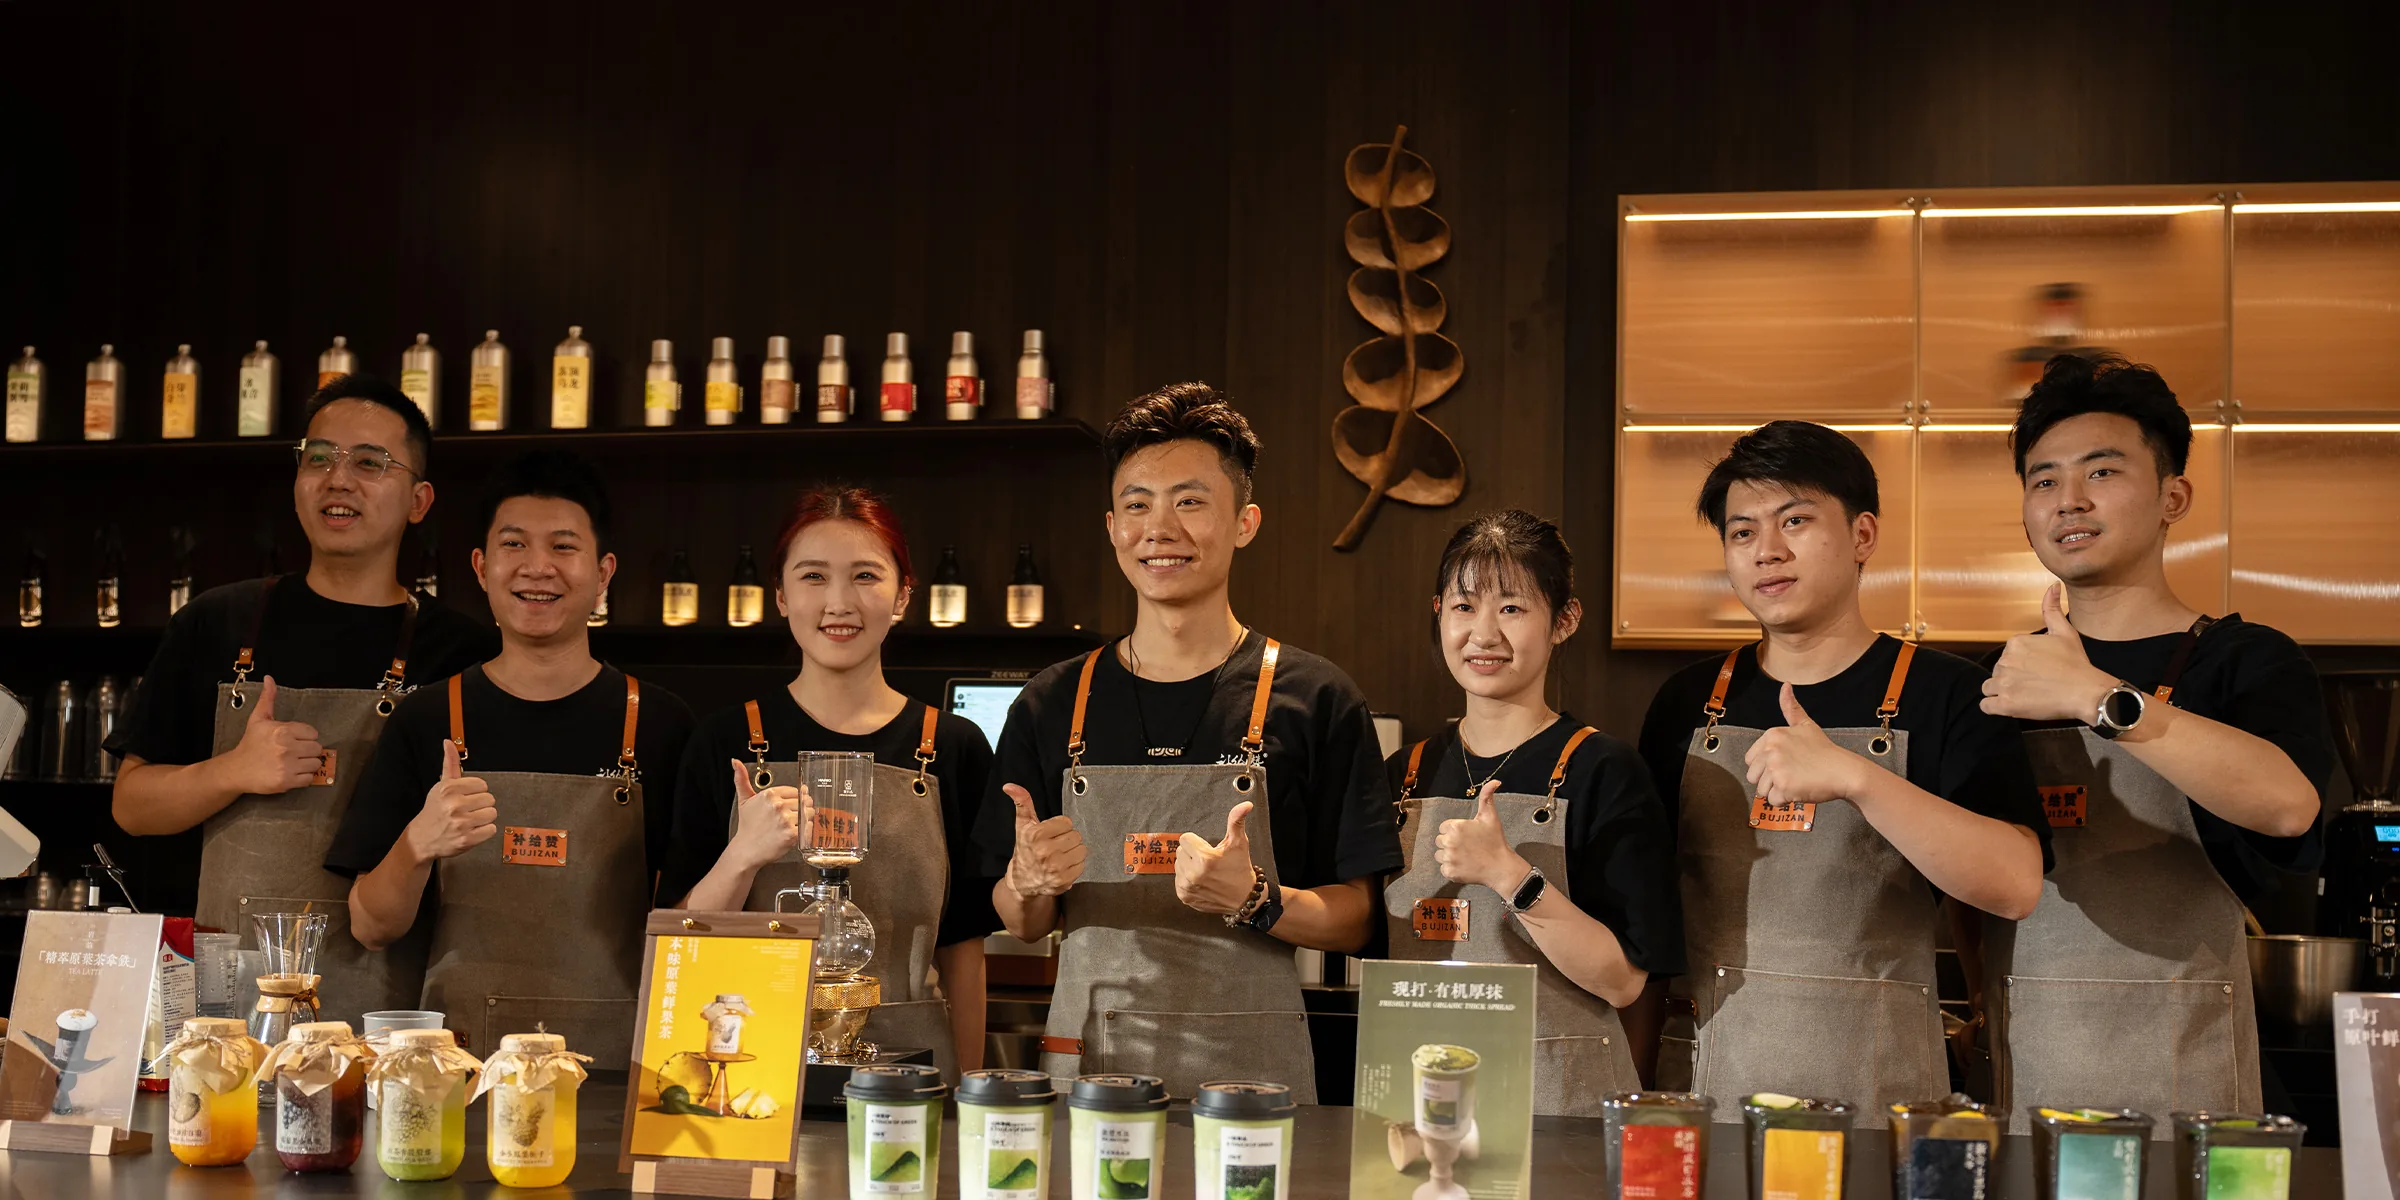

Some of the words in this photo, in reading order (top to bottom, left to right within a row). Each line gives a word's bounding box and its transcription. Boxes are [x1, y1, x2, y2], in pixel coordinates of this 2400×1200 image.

[1760, 813, 1804, 822] BUJIZAN
[512, 834, 558, 848] 补给赞
[511, 848, 559, 858] BUJIZAN
[1422, 906, 1460, 920] 补给赞
[1421, 923, 1461, 931] BUJIZAN
[1412, 1001, 1431, 1009] MADE
